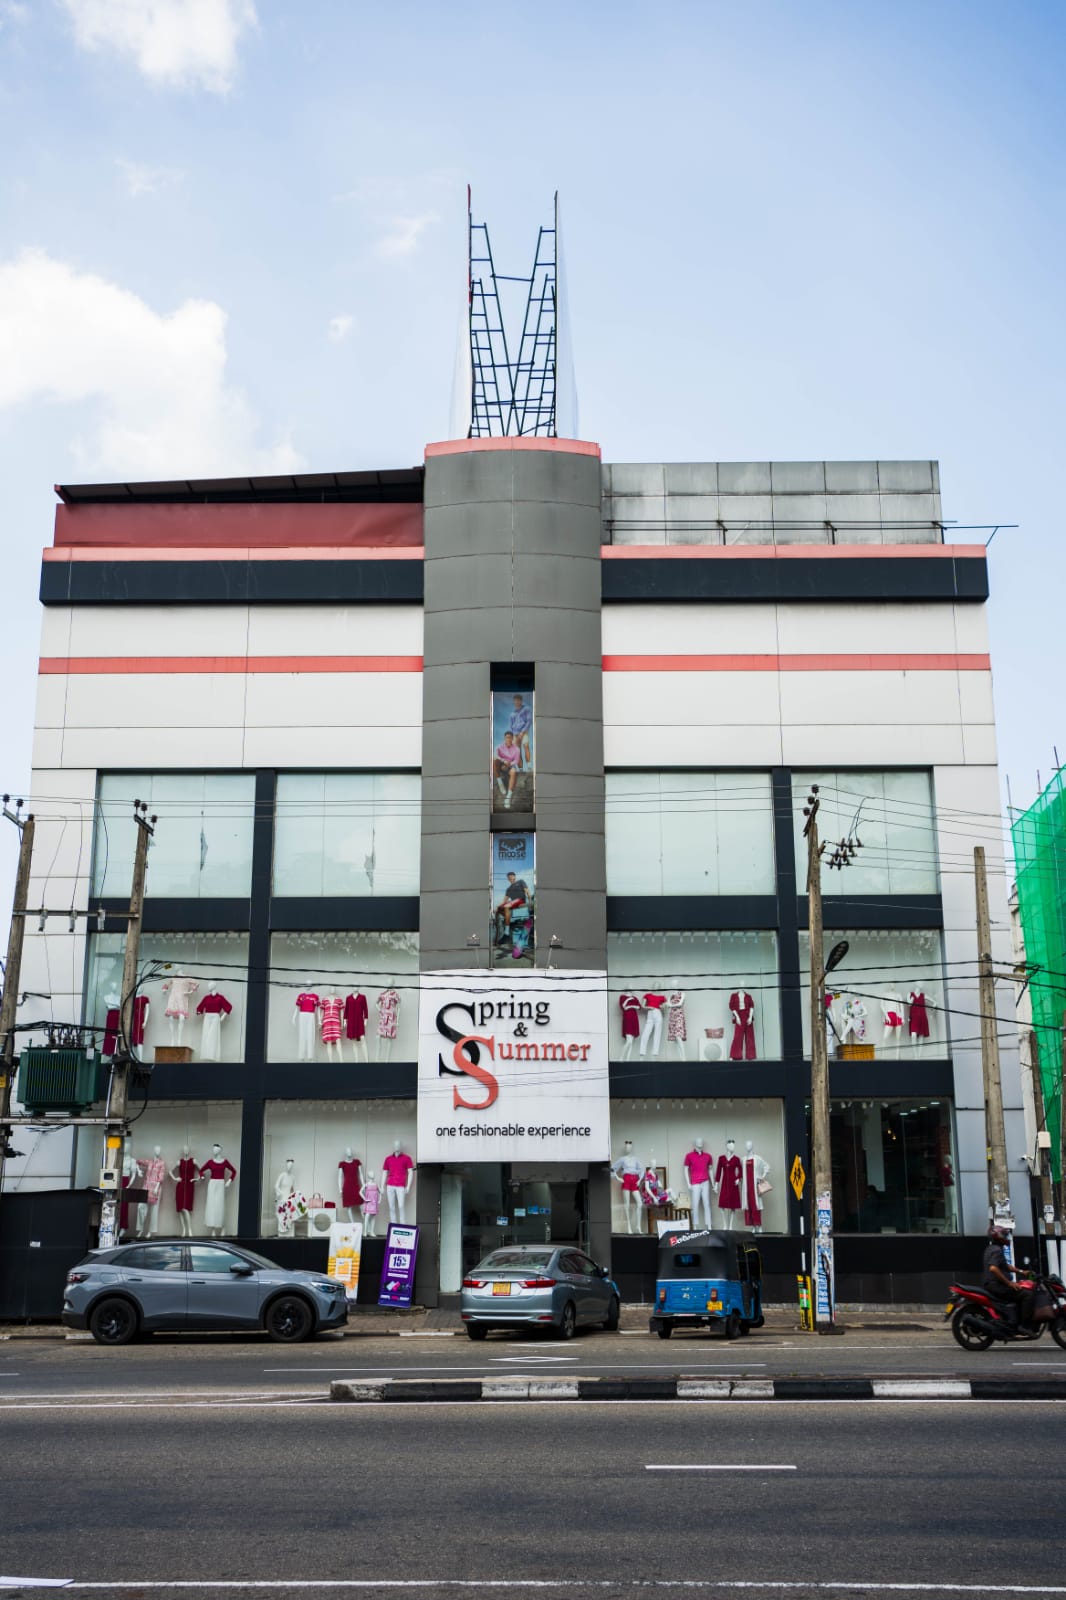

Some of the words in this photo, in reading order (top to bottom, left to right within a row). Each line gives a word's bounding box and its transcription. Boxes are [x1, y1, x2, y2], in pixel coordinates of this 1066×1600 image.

[498, 850, 526, 859] moose
[436, 994, 551, 1077] Spring
[513, 1022, 528, 1037] &
[453, 1035, 591, 1111] Summer
[436, 1126, 456, 1137] one
[458, 1123, 525, 1137] fashionable
[527, 1123, 591, 1139] experience
